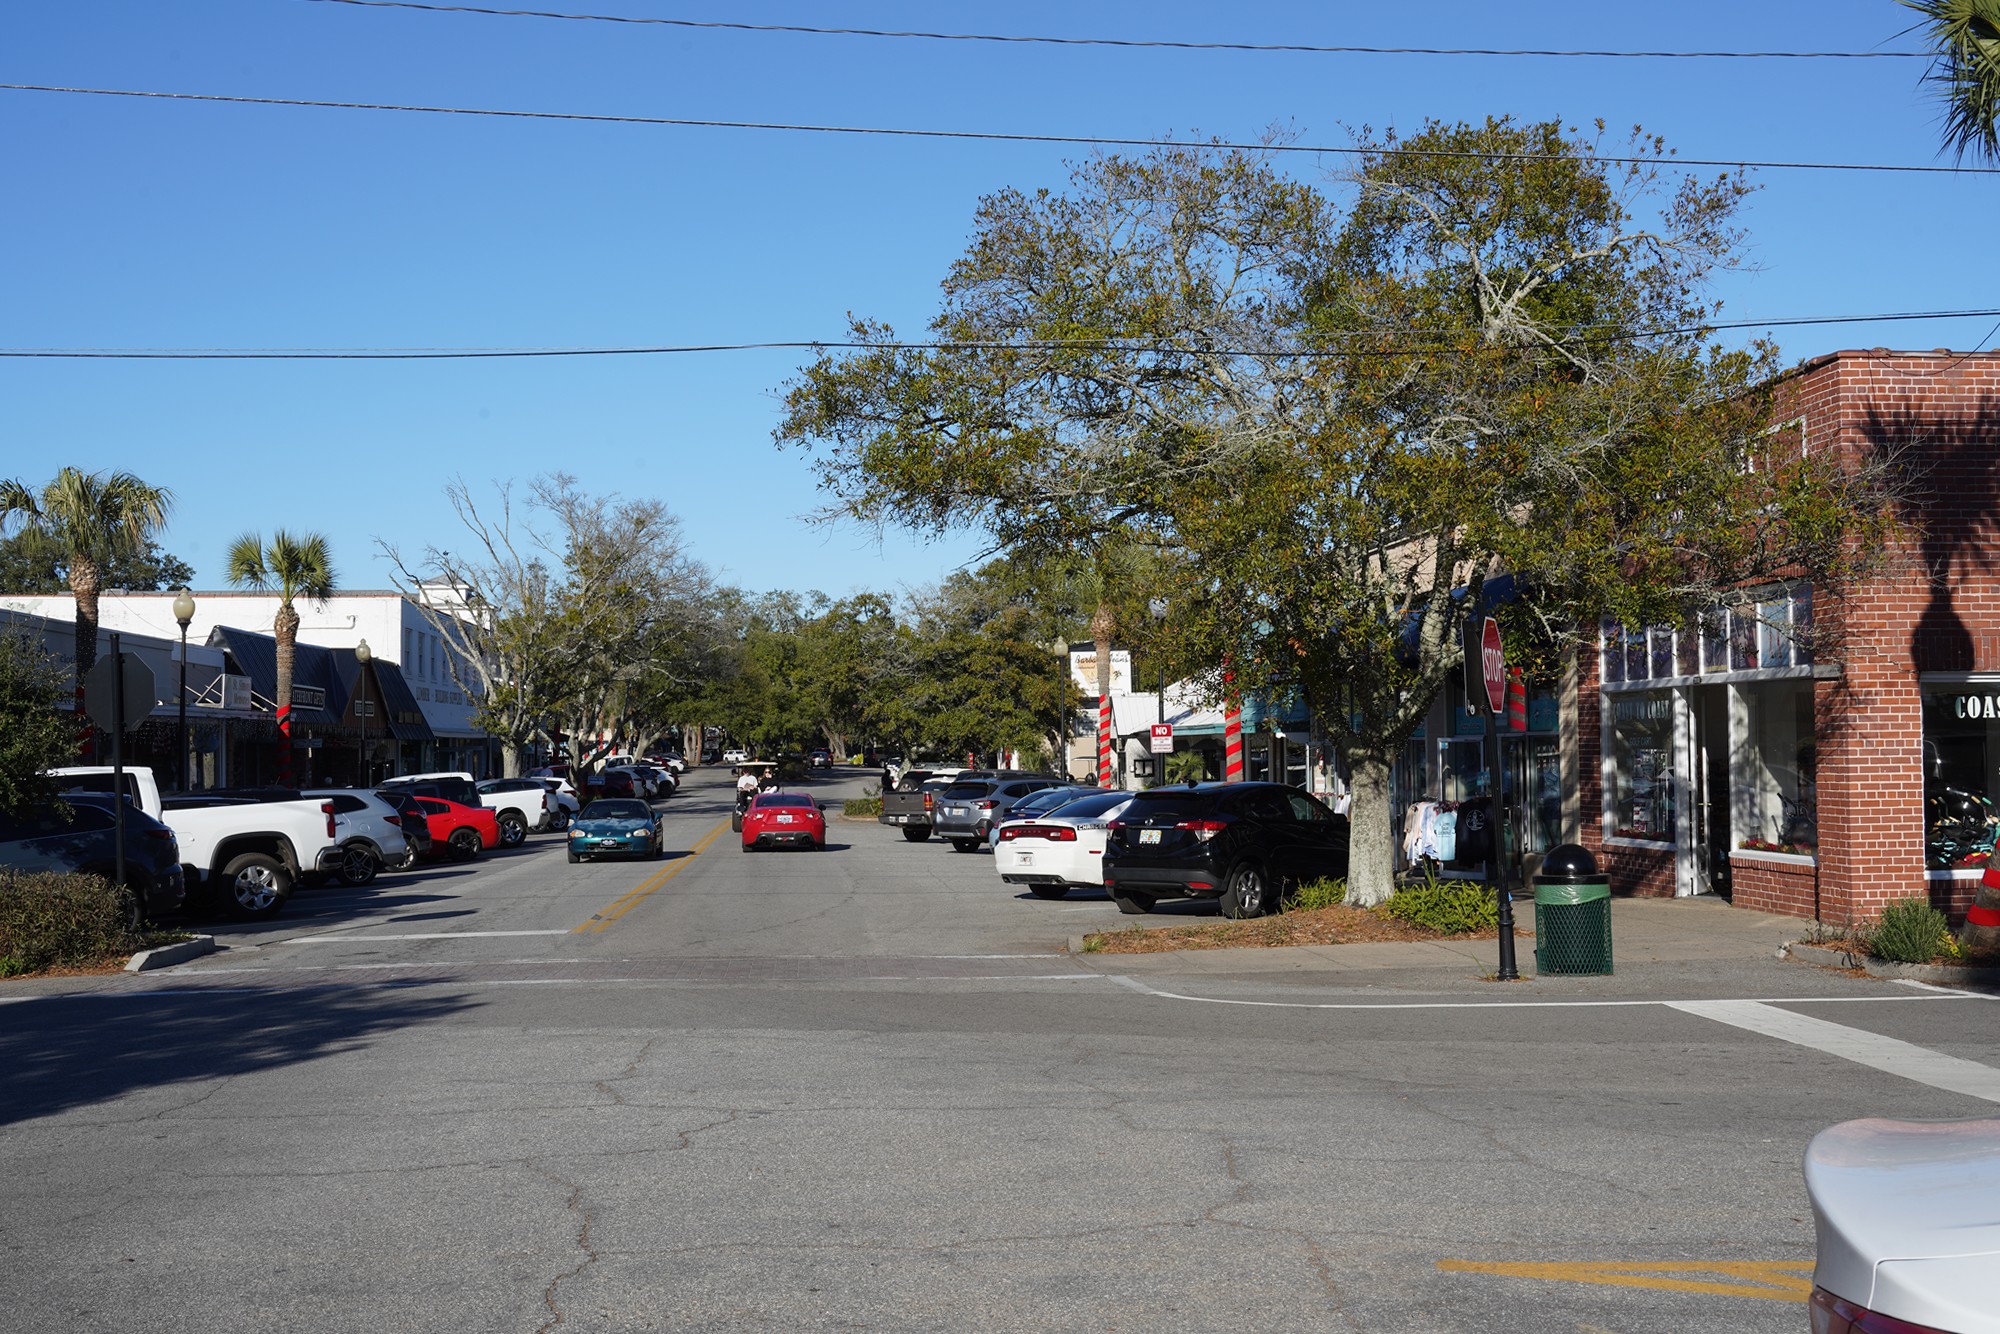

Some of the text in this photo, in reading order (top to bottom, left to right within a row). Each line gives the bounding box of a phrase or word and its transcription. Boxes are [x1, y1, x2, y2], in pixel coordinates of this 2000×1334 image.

[1075, 654, 1098, 664] Barba
[1484, 648, 1503, 682] STOP
[292, 689, 314, 705] ATERFRONT
[1636, 702, 1645, 720] TO
[1647, 700, 1670, 720] COAST
[1155, 727, 1168, 736] NO
